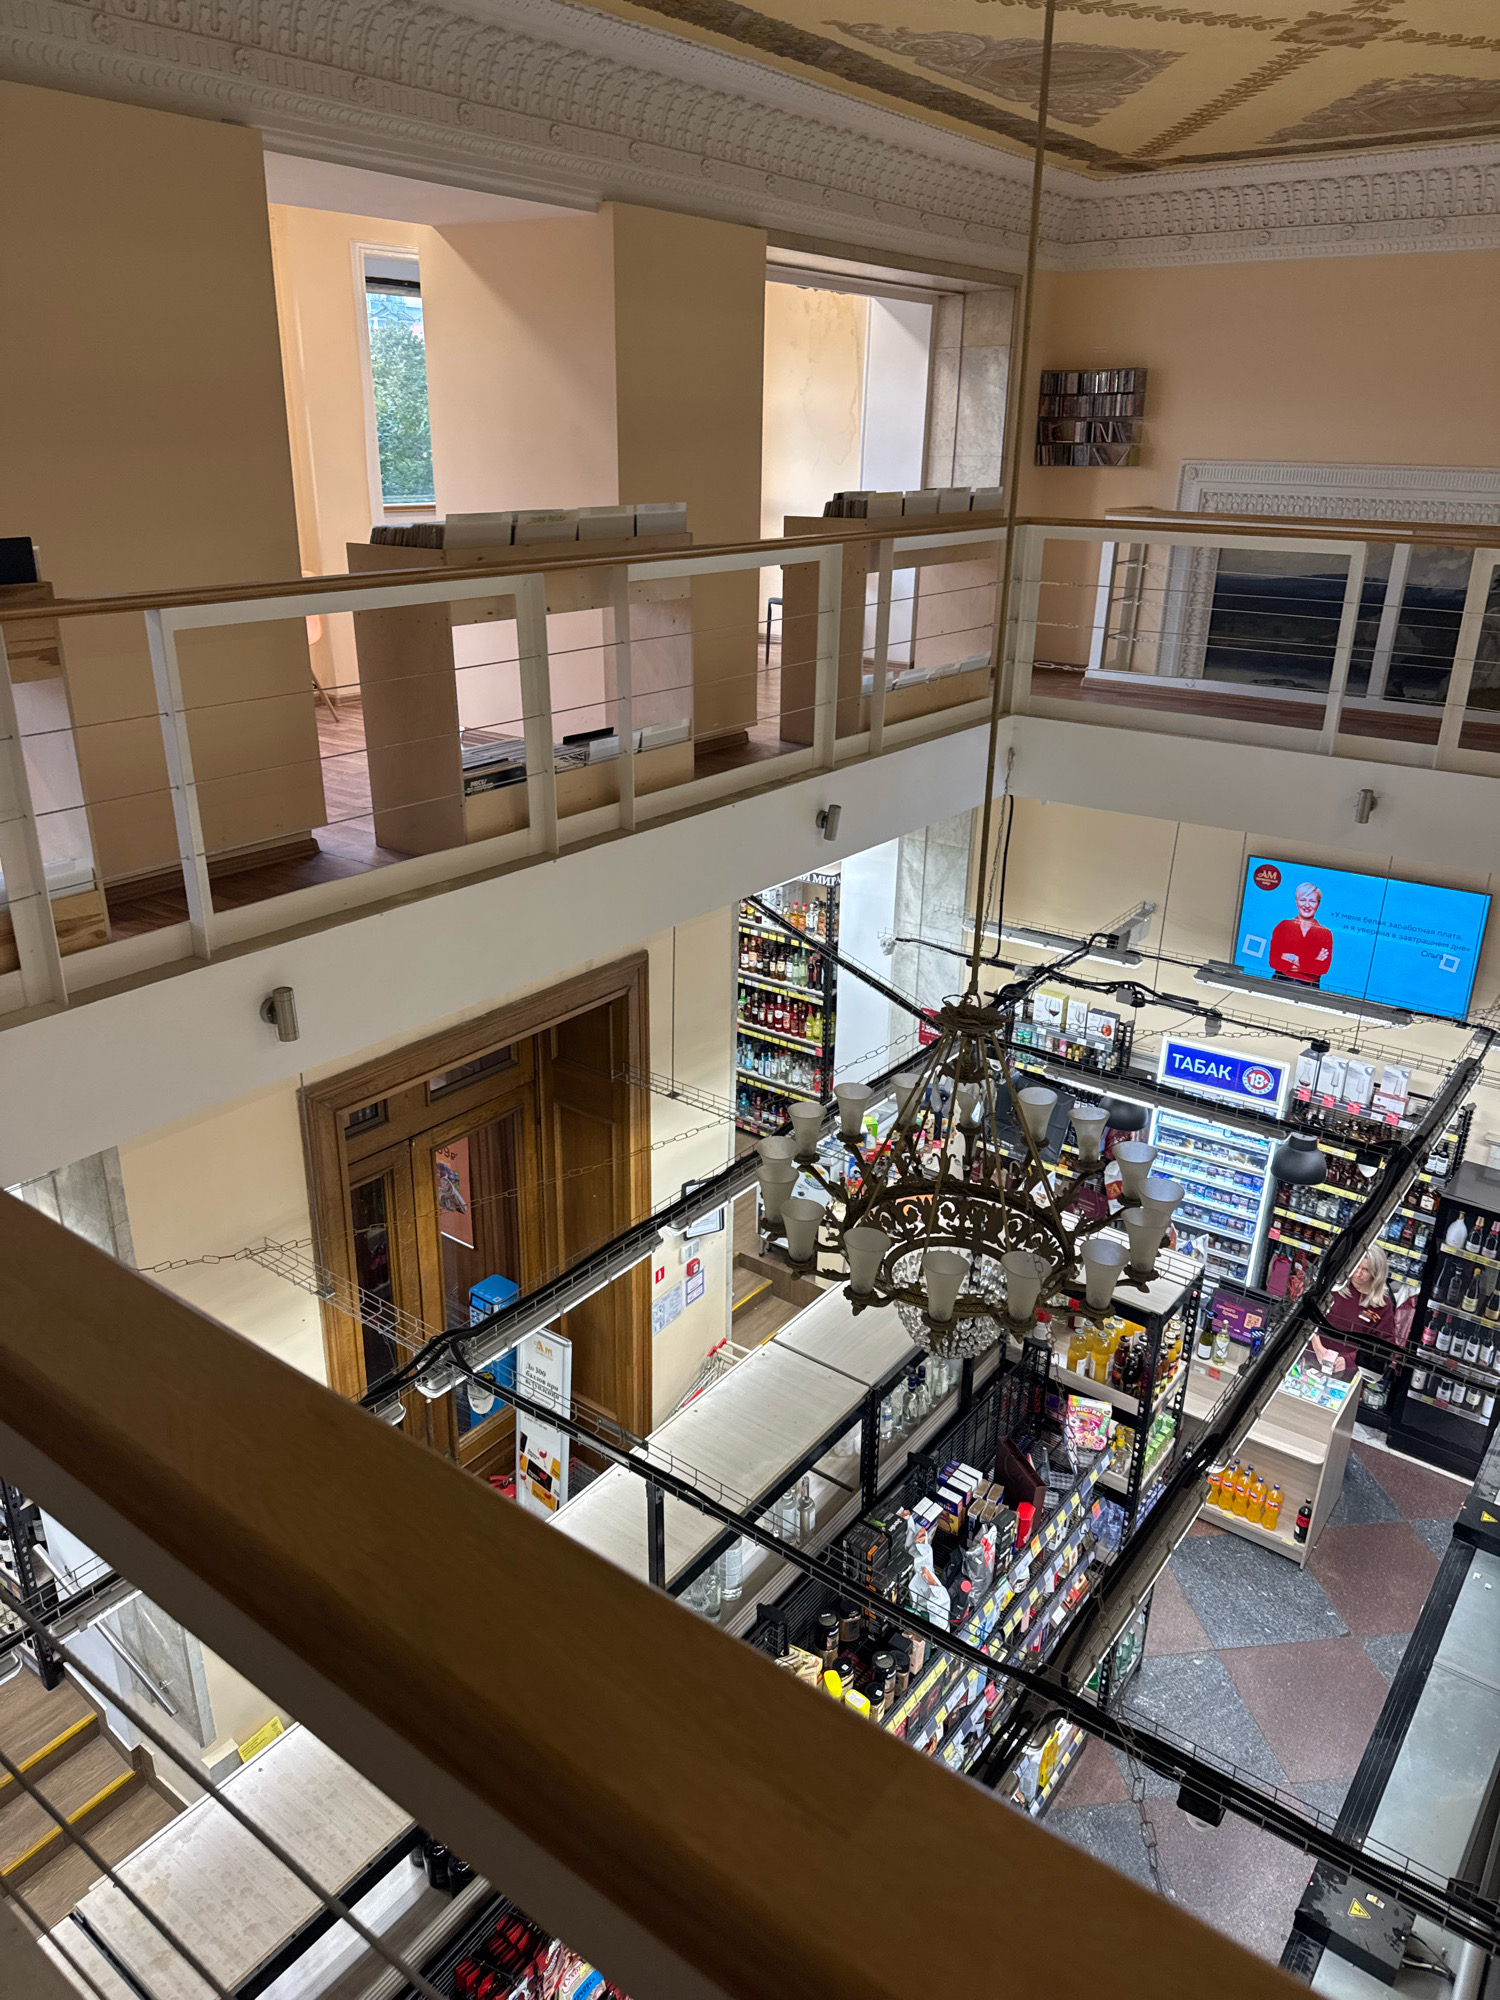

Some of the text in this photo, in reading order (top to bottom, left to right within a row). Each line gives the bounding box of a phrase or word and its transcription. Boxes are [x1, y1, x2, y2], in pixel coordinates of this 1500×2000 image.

[812, 873, 841, 886] МИРА
[1341, 913, 1361, 922] меня
[1363, 915, 1386, 927] белая
[1388, 921, 1435, 936] заработная
[1437, 930, 1463, 942] плата,
[1356, 926, 1390, 938] уверена
[1398, 934, 1449, 949] завтрашнем
[1421, 949, 1443, 961] Ольга
[1172, 1053, 1232, 1081] ТАБАК
[1248, 1072, 1270, 1088] 18+
[535, 1366, 546, 1378] 300
[525, 1370, 559, 1392] баллов при
[1070, 1406, 1102, 1417] UNICORN
